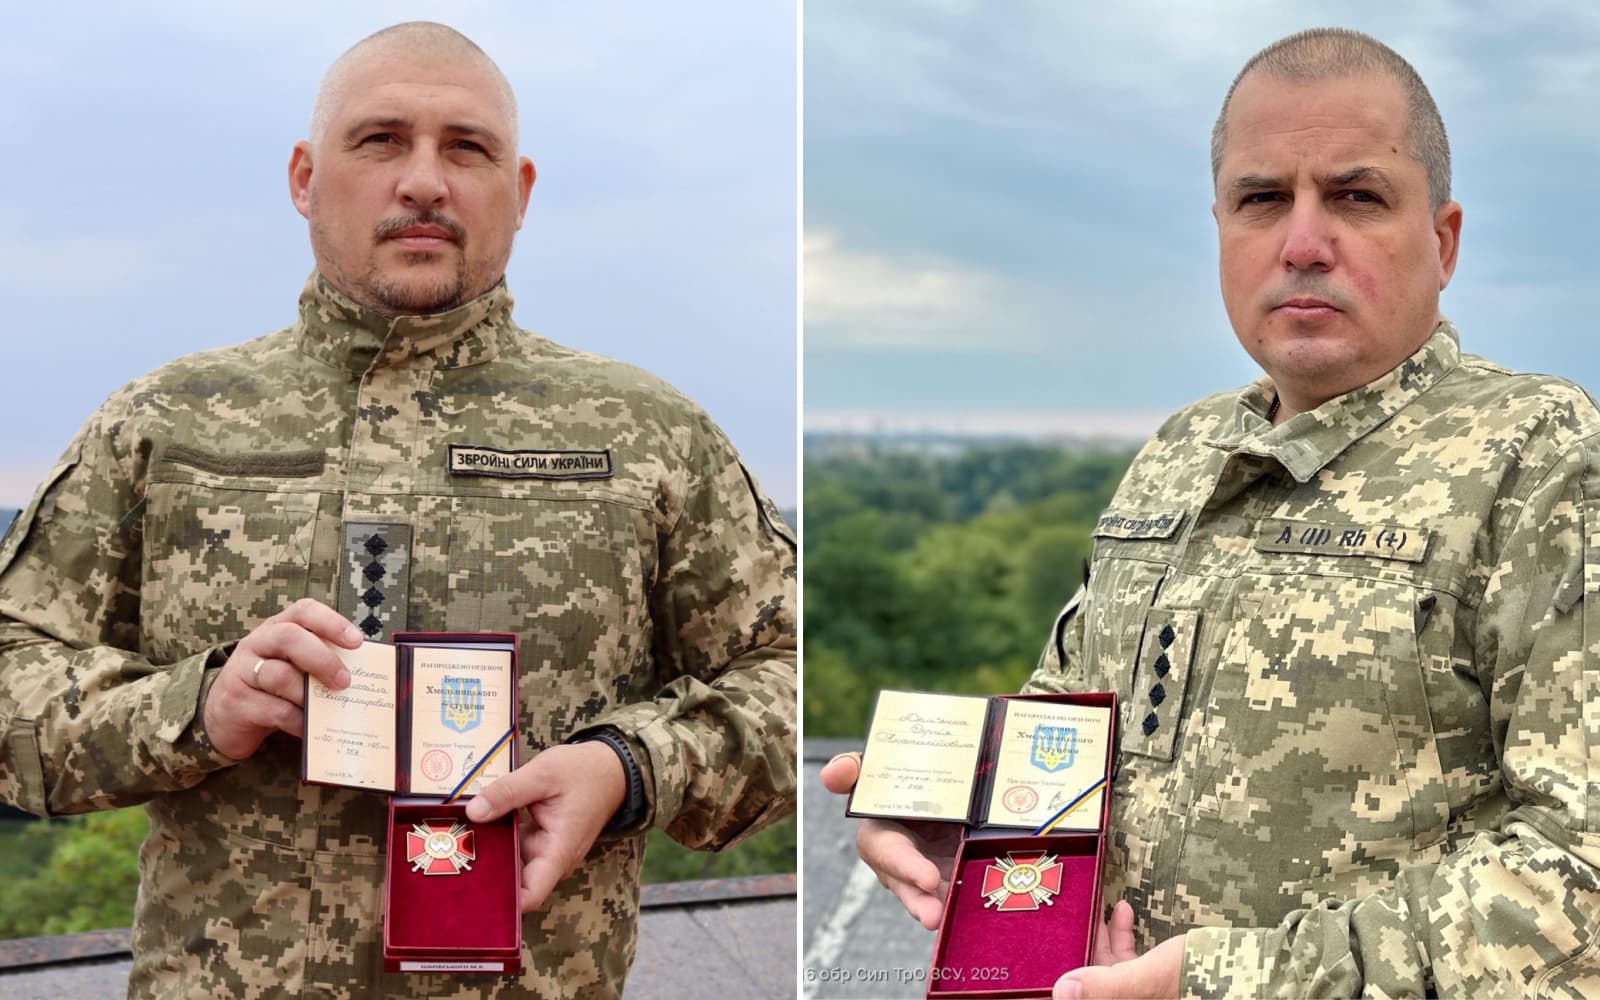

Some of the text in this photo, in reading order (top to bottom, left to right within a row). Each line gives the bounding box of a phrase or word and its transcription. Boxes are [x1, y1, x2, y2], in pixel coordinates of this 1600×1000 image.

[457, 453, 604, 470] ЗБРОЙНІ СИЛИ УКРАЇНИ
[1275, 526, 1292, 544] A
[1338, 529, 1368, 547] Rh
[1376, 530, 1407, 551] (+)
